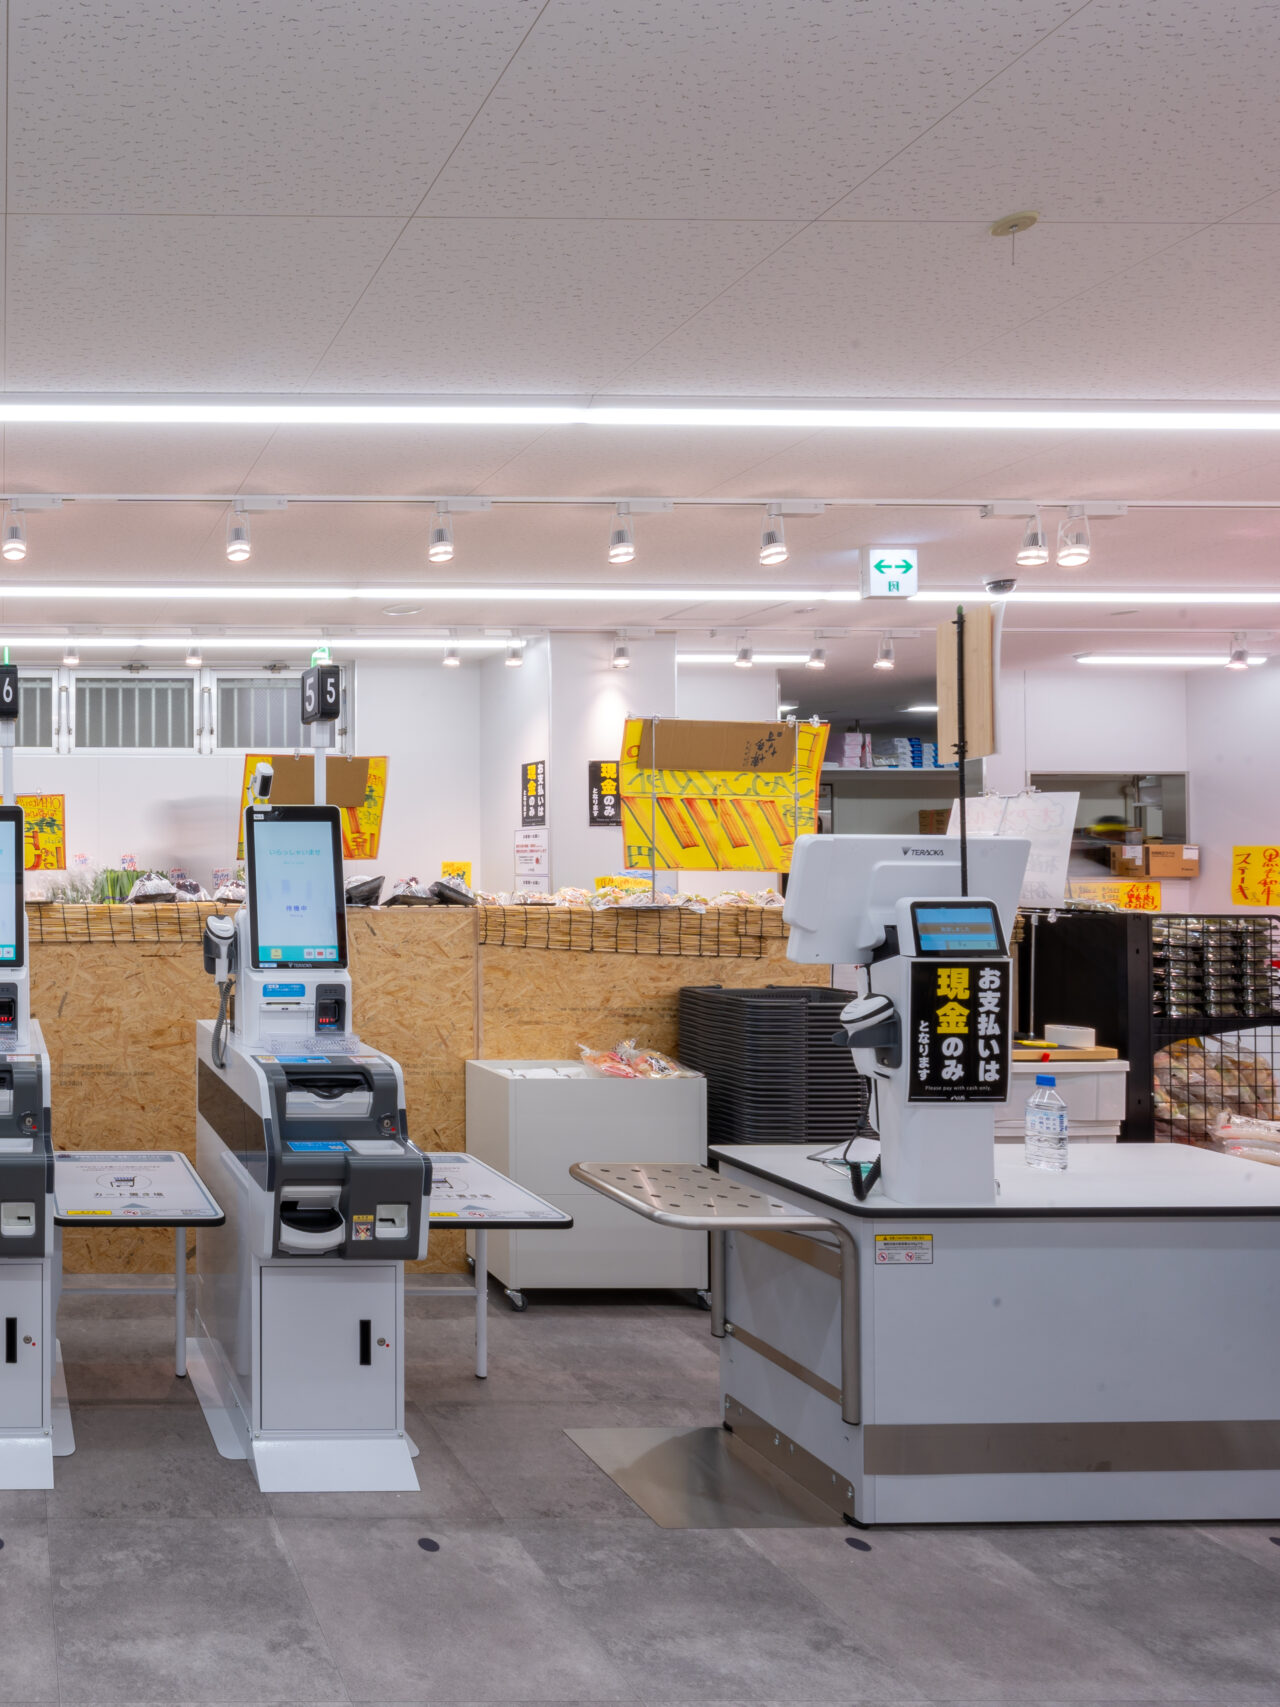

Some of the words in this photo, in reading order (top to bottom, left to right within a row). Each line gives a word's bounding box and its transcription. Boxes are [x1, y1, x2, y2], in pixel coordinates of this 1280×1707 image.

[2, 679, 13, 703] 6
[305, 678, 315, 711] 5
[326, 679, 336, 703] 5
[527, 764, 536, 817] 現金のみ
[600, 762, 617, 817] 現金のみ
[918, 1020, 929, 1082] となります
[935, 966, 971, 1082] 現金のみ
[977, 967, 1002, 1083] お支払いは
